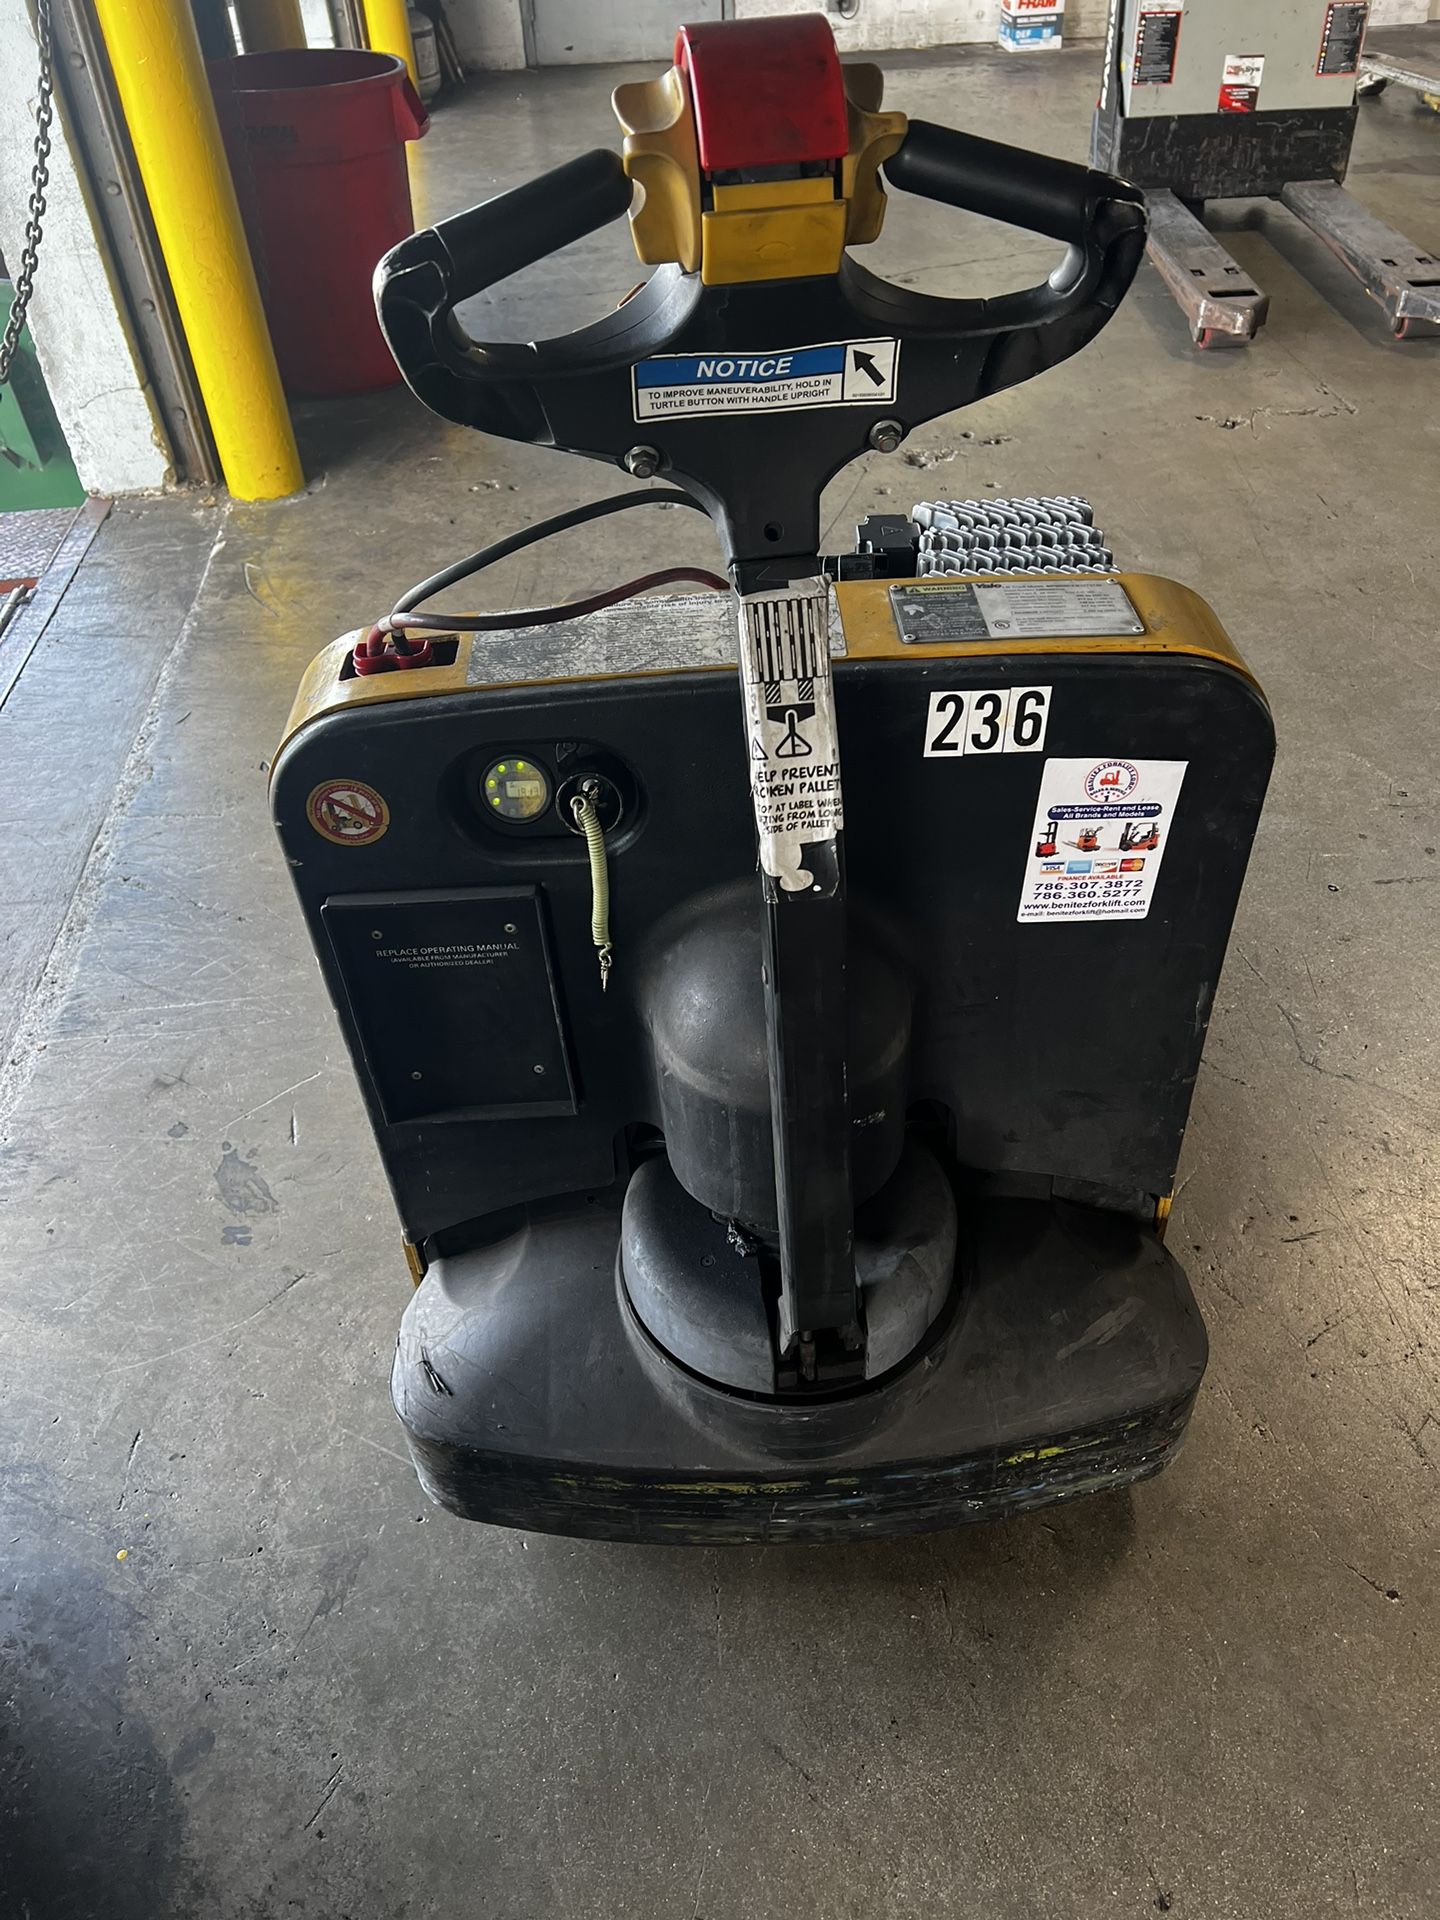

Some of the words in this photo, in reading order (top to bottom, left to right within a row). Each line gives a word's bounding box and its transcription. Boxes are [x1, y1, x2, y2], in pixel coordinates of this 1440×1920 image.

[696, 356, 794, 378] NOTICE
[648, 391, 661, 400] TO
[663, 388, 705, 399] IMPROVE
[706, 383, 794, 395] MANEUVERABILITY,
[795, 380, 821, 389] HOLD
[822, 378, 832, 386] IN
[650, 399, 686, 410] TURTLE
[687, 397, 724, 407] BUTTON
[726, 395, 750, 404] WITH
[751, 393, 788, 403] HANDLE
[790, 388, 831, 400] UPRIGHT
[930, 690, 1046, 751] 236
[757, 769, 777, 783] ELP
[781, 762, 839, 781] PREVENT
[776, 802, 786, 813] AT
[789, 799, 814, 811] LABEL
[1051, 805, 1121, 813] Sales-Service-Rent
[786, 811, 816, 821] FROM
[786, 821, 799, 832] OF
[801, 819, 830, 829] PALLET
[1034, 880, 1144, 891] 786.307.3872
[1033, 889, 1142, 900] 786.360.5277
[1024, 900, 1146, 910] www.benitezforklift.com
[1046, 907, 1146, 917] benitezforklift@hotmail.com
[376, 948, 418, 957] REPLACE
[420, 945, 475, 955] OPERATING
[476, 943, 520, 951] MANUAL
